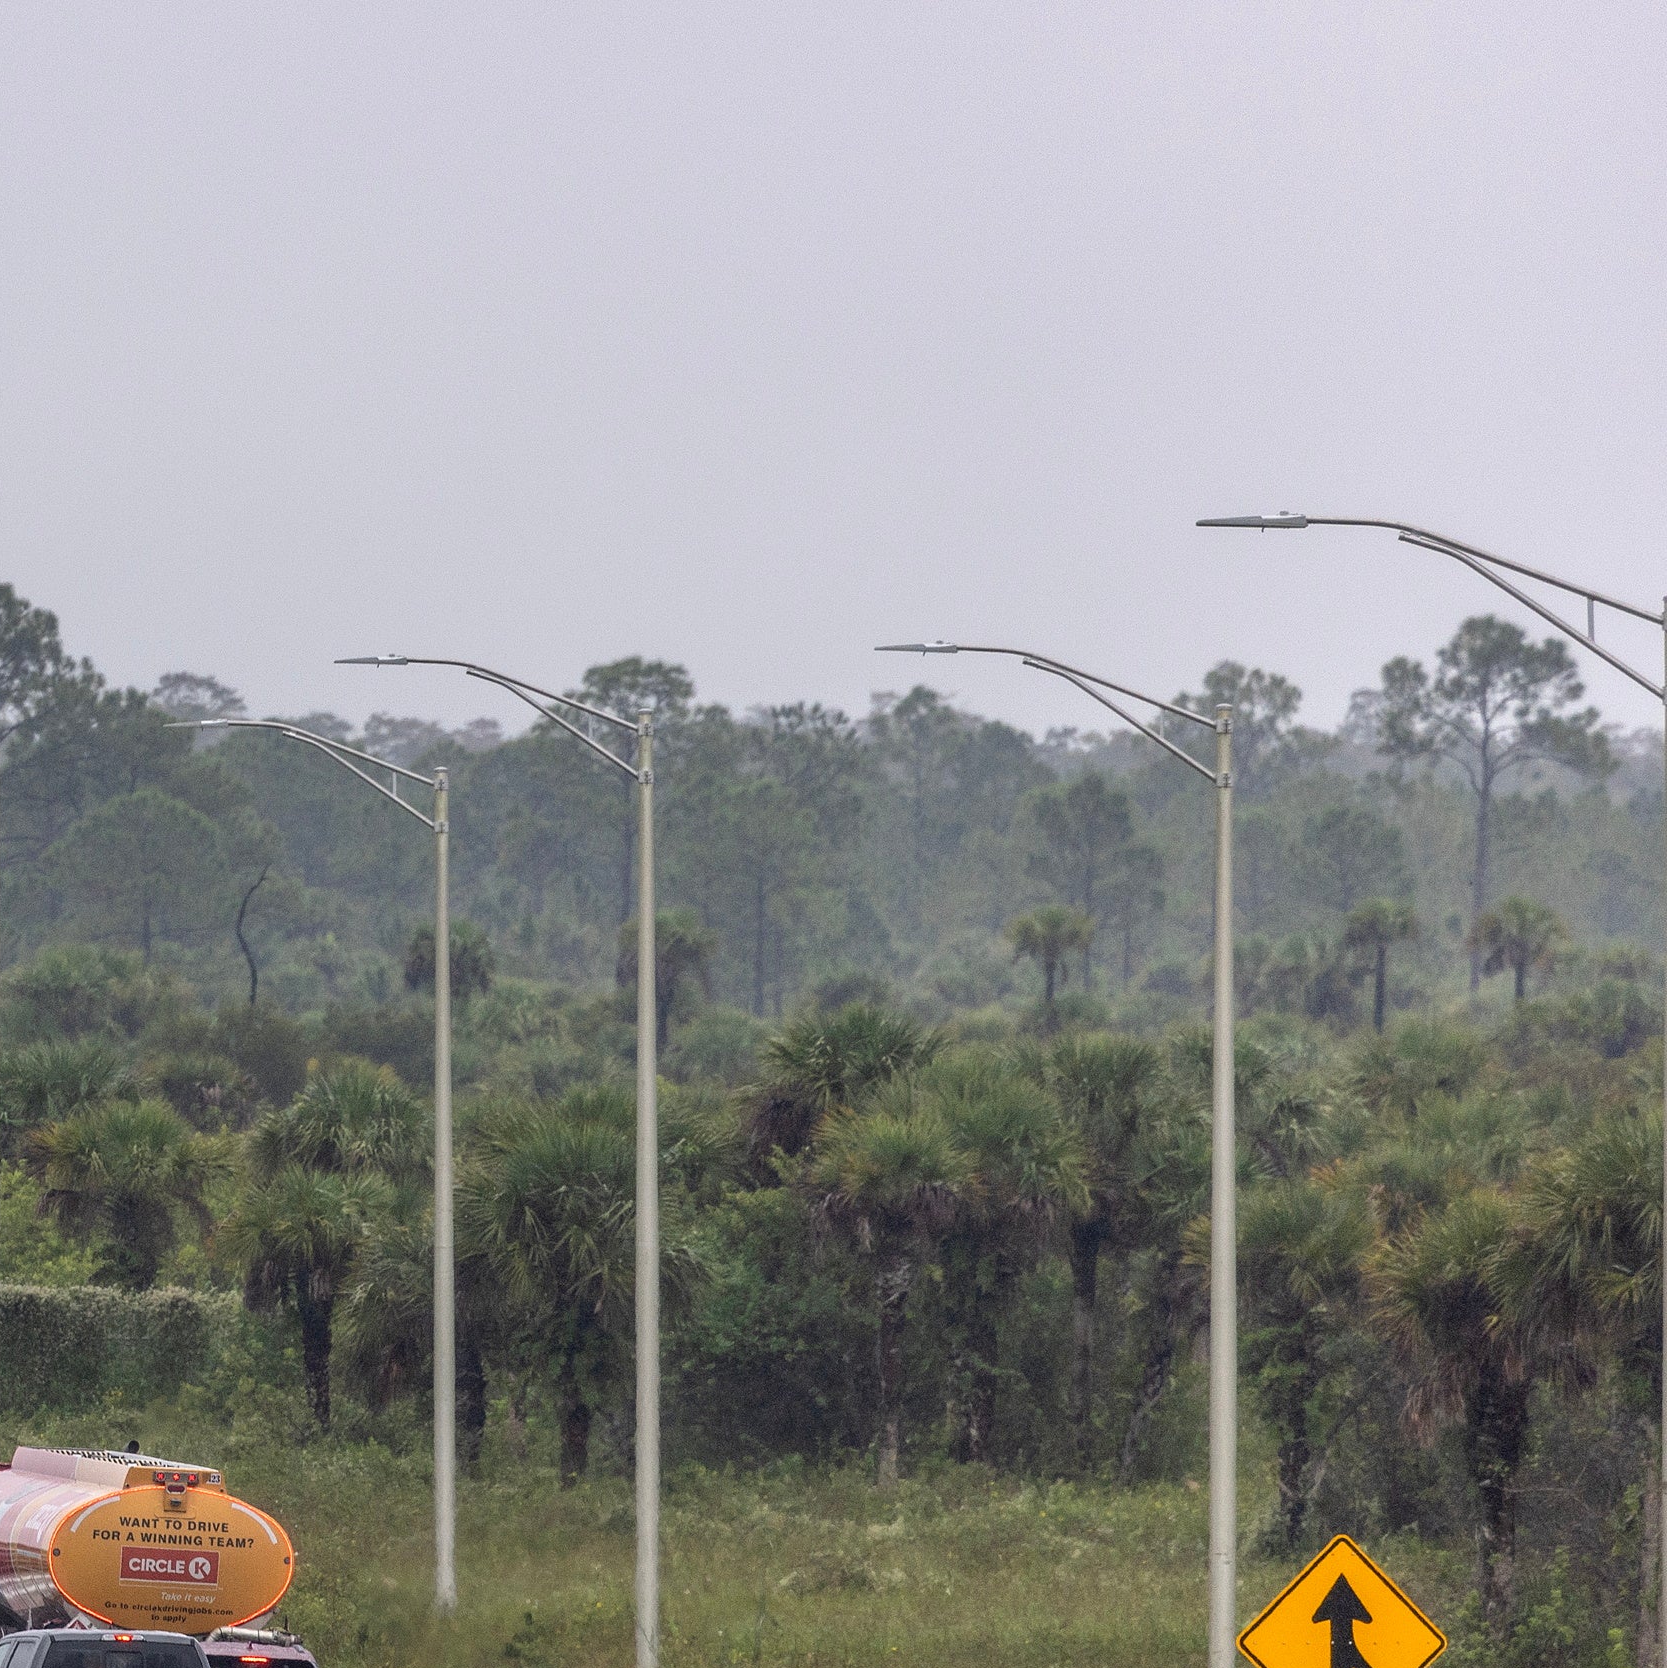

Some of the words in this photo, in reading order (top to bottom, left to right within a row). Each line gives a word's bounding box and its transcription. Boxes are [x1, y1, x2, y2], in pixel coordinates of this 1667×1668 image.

[119, 1516, 160, 1529] WANT
[166, 1518, 183, 1530] TO
[188, 1521, 229, 1533] DRIVE
[92, 1530, 121, 1541] FOR
[126, 1532, 135, 1542] A
[141, 1533, 203, 1546] WINNING
[209, 1536, 255, 1549] TEAM?
[128, 1556, 186, 1575] CIRCLE
[192, 1559, 210, 1577] K
[160, 1591, 182, 1602] Take
[185, 1592, 192, 1602] it
[194, 1595, 216, 1604] easy
[104, 1602, 117, 1610] Go
[120, 1602, 129, 1610] to
[132, 1603, 234, 1616] circlekdrivingjobs.com
[151, 1613, 160, 1622] to
[163, 1614, 187, 1623] apply
